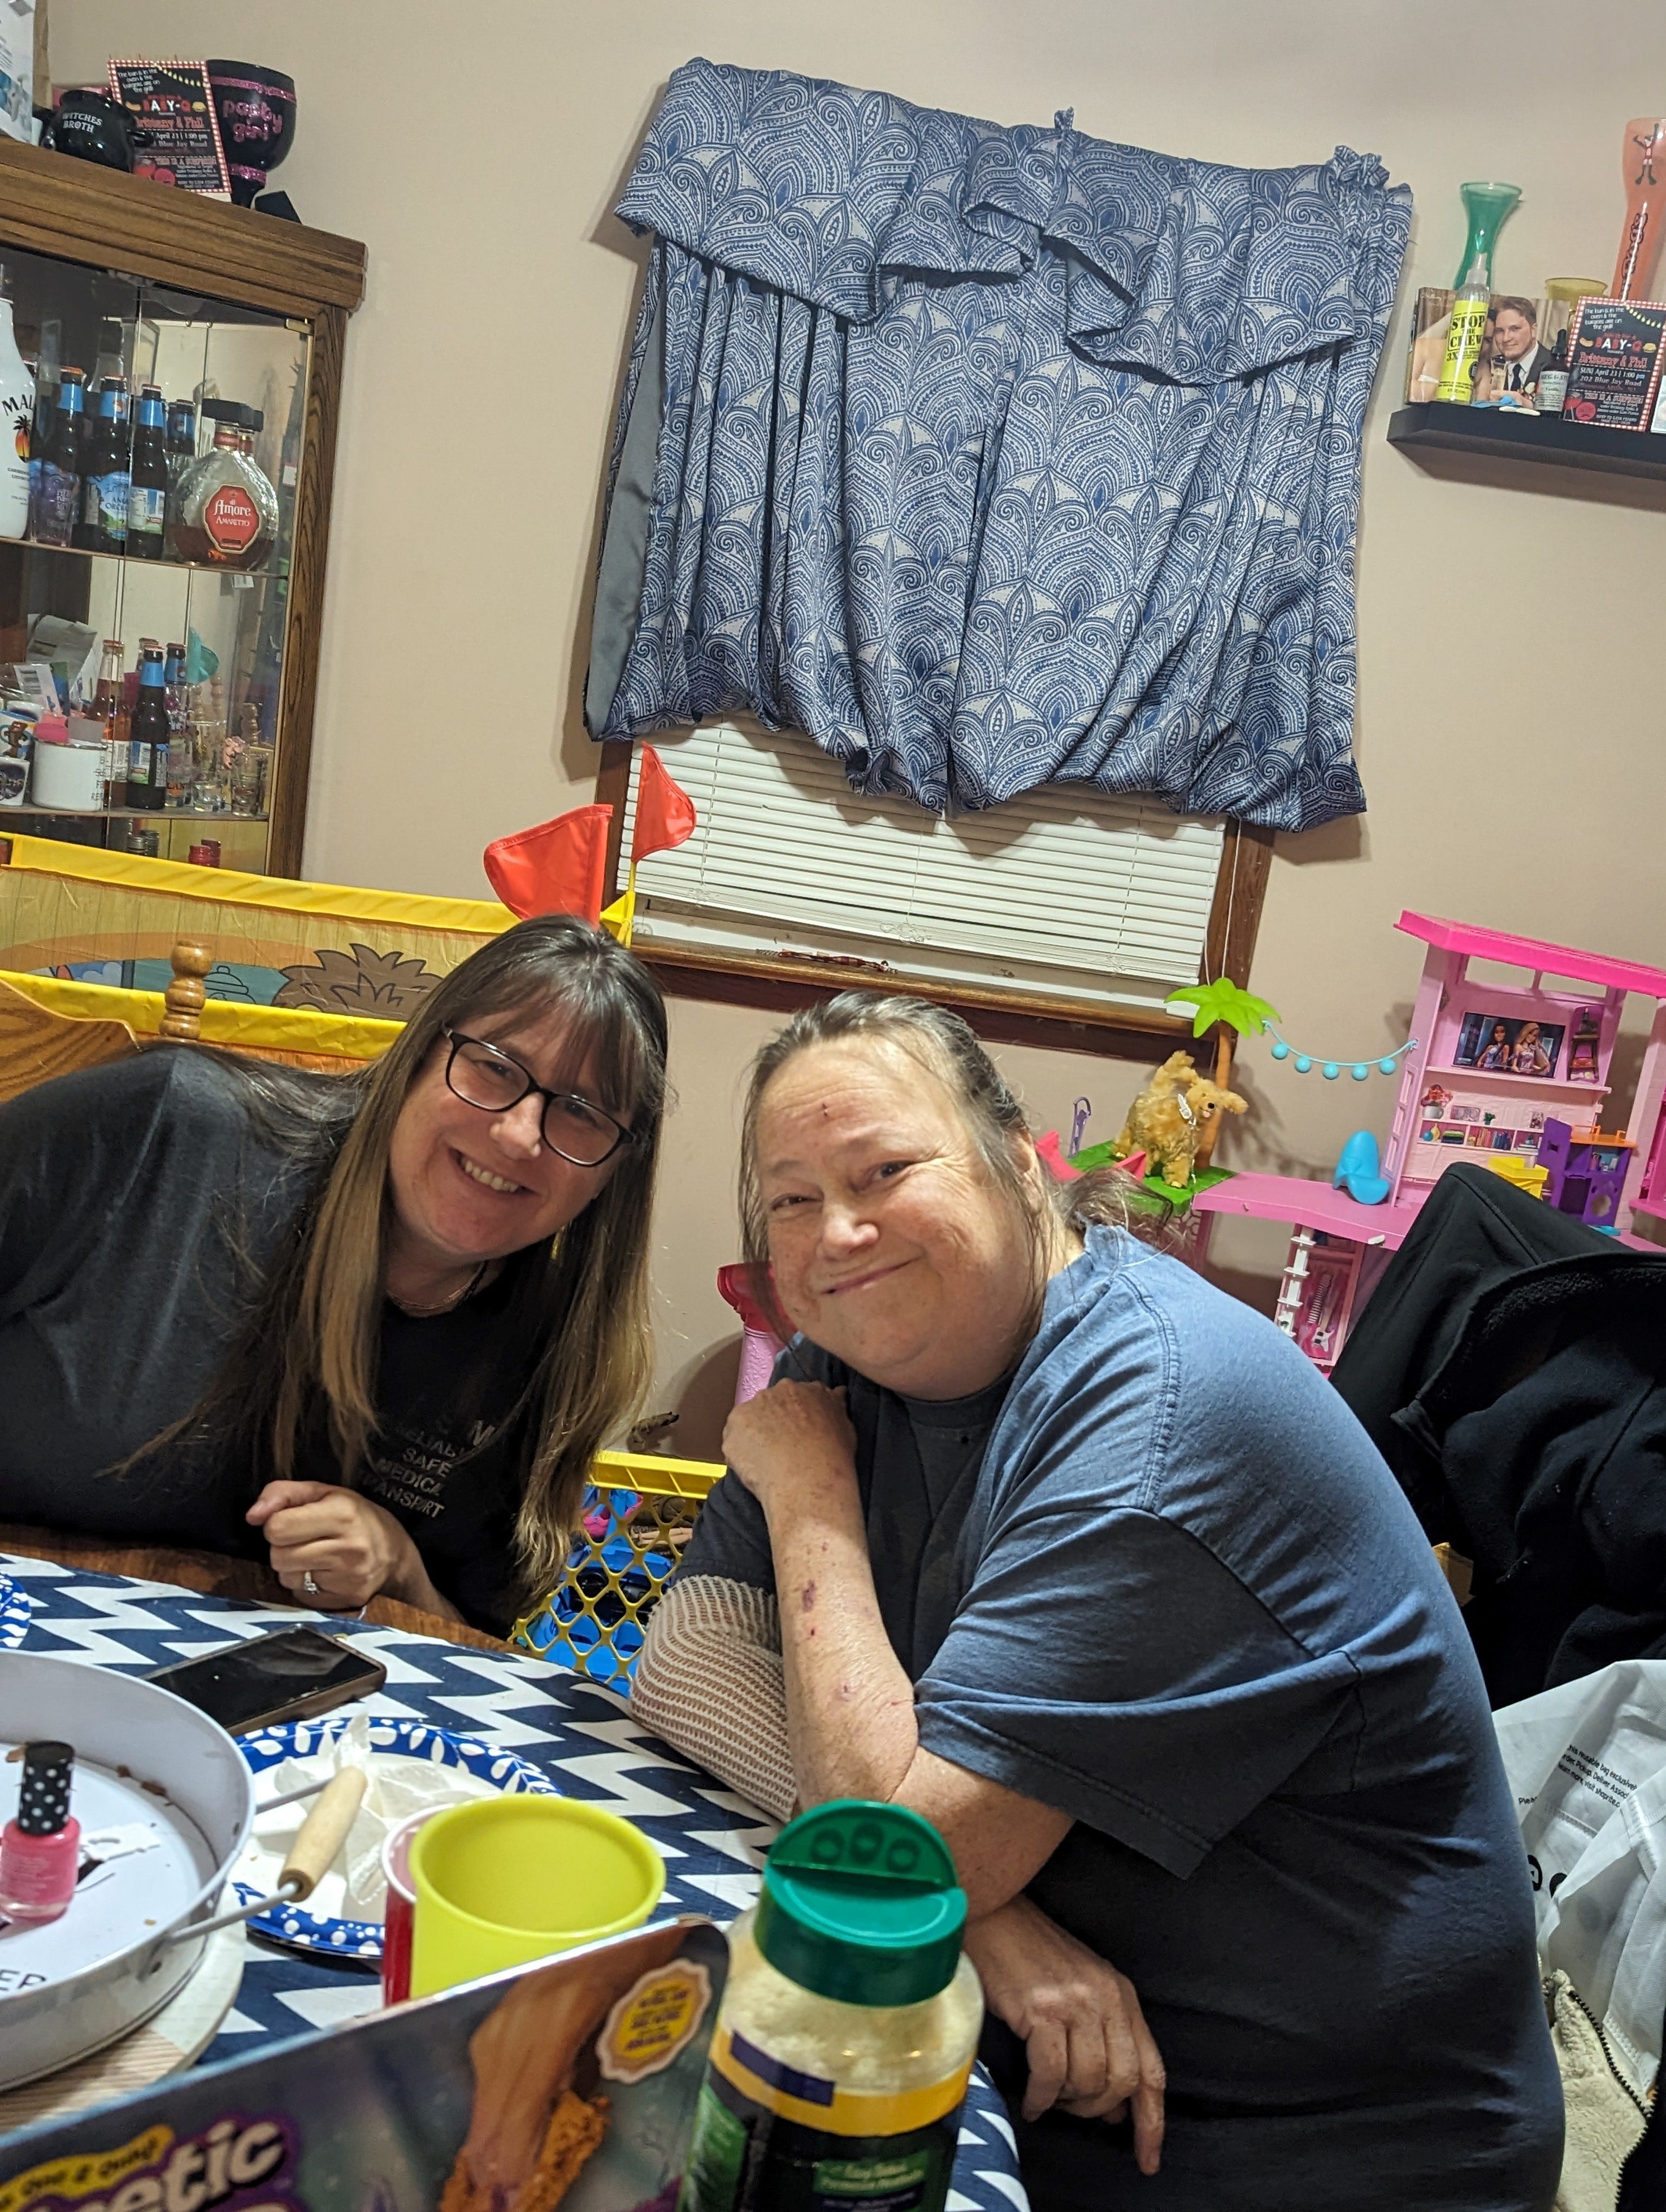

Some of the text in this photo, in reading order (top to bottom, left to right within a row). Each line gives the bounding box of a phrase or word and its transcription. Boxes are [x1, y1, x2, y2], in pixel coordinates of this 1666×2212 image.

[62, 112, 102, 126] WITCHES
[223, 100, 283, 134] party
[63, 120, 94, 133] BROTH
[233, 119, 270, 143] girl
[1451, 315, 1485, 331] STOP
[1627, 356, 1648, 368] Phil
[1594, 369, 1609, 377] April
[214, 500, 251, 516] Amore
[403, 1447, 452, 1477] SAFE
[1600, 1764, 1610, 1776] bag
[1584, 1780, 1595, 1792] visit
